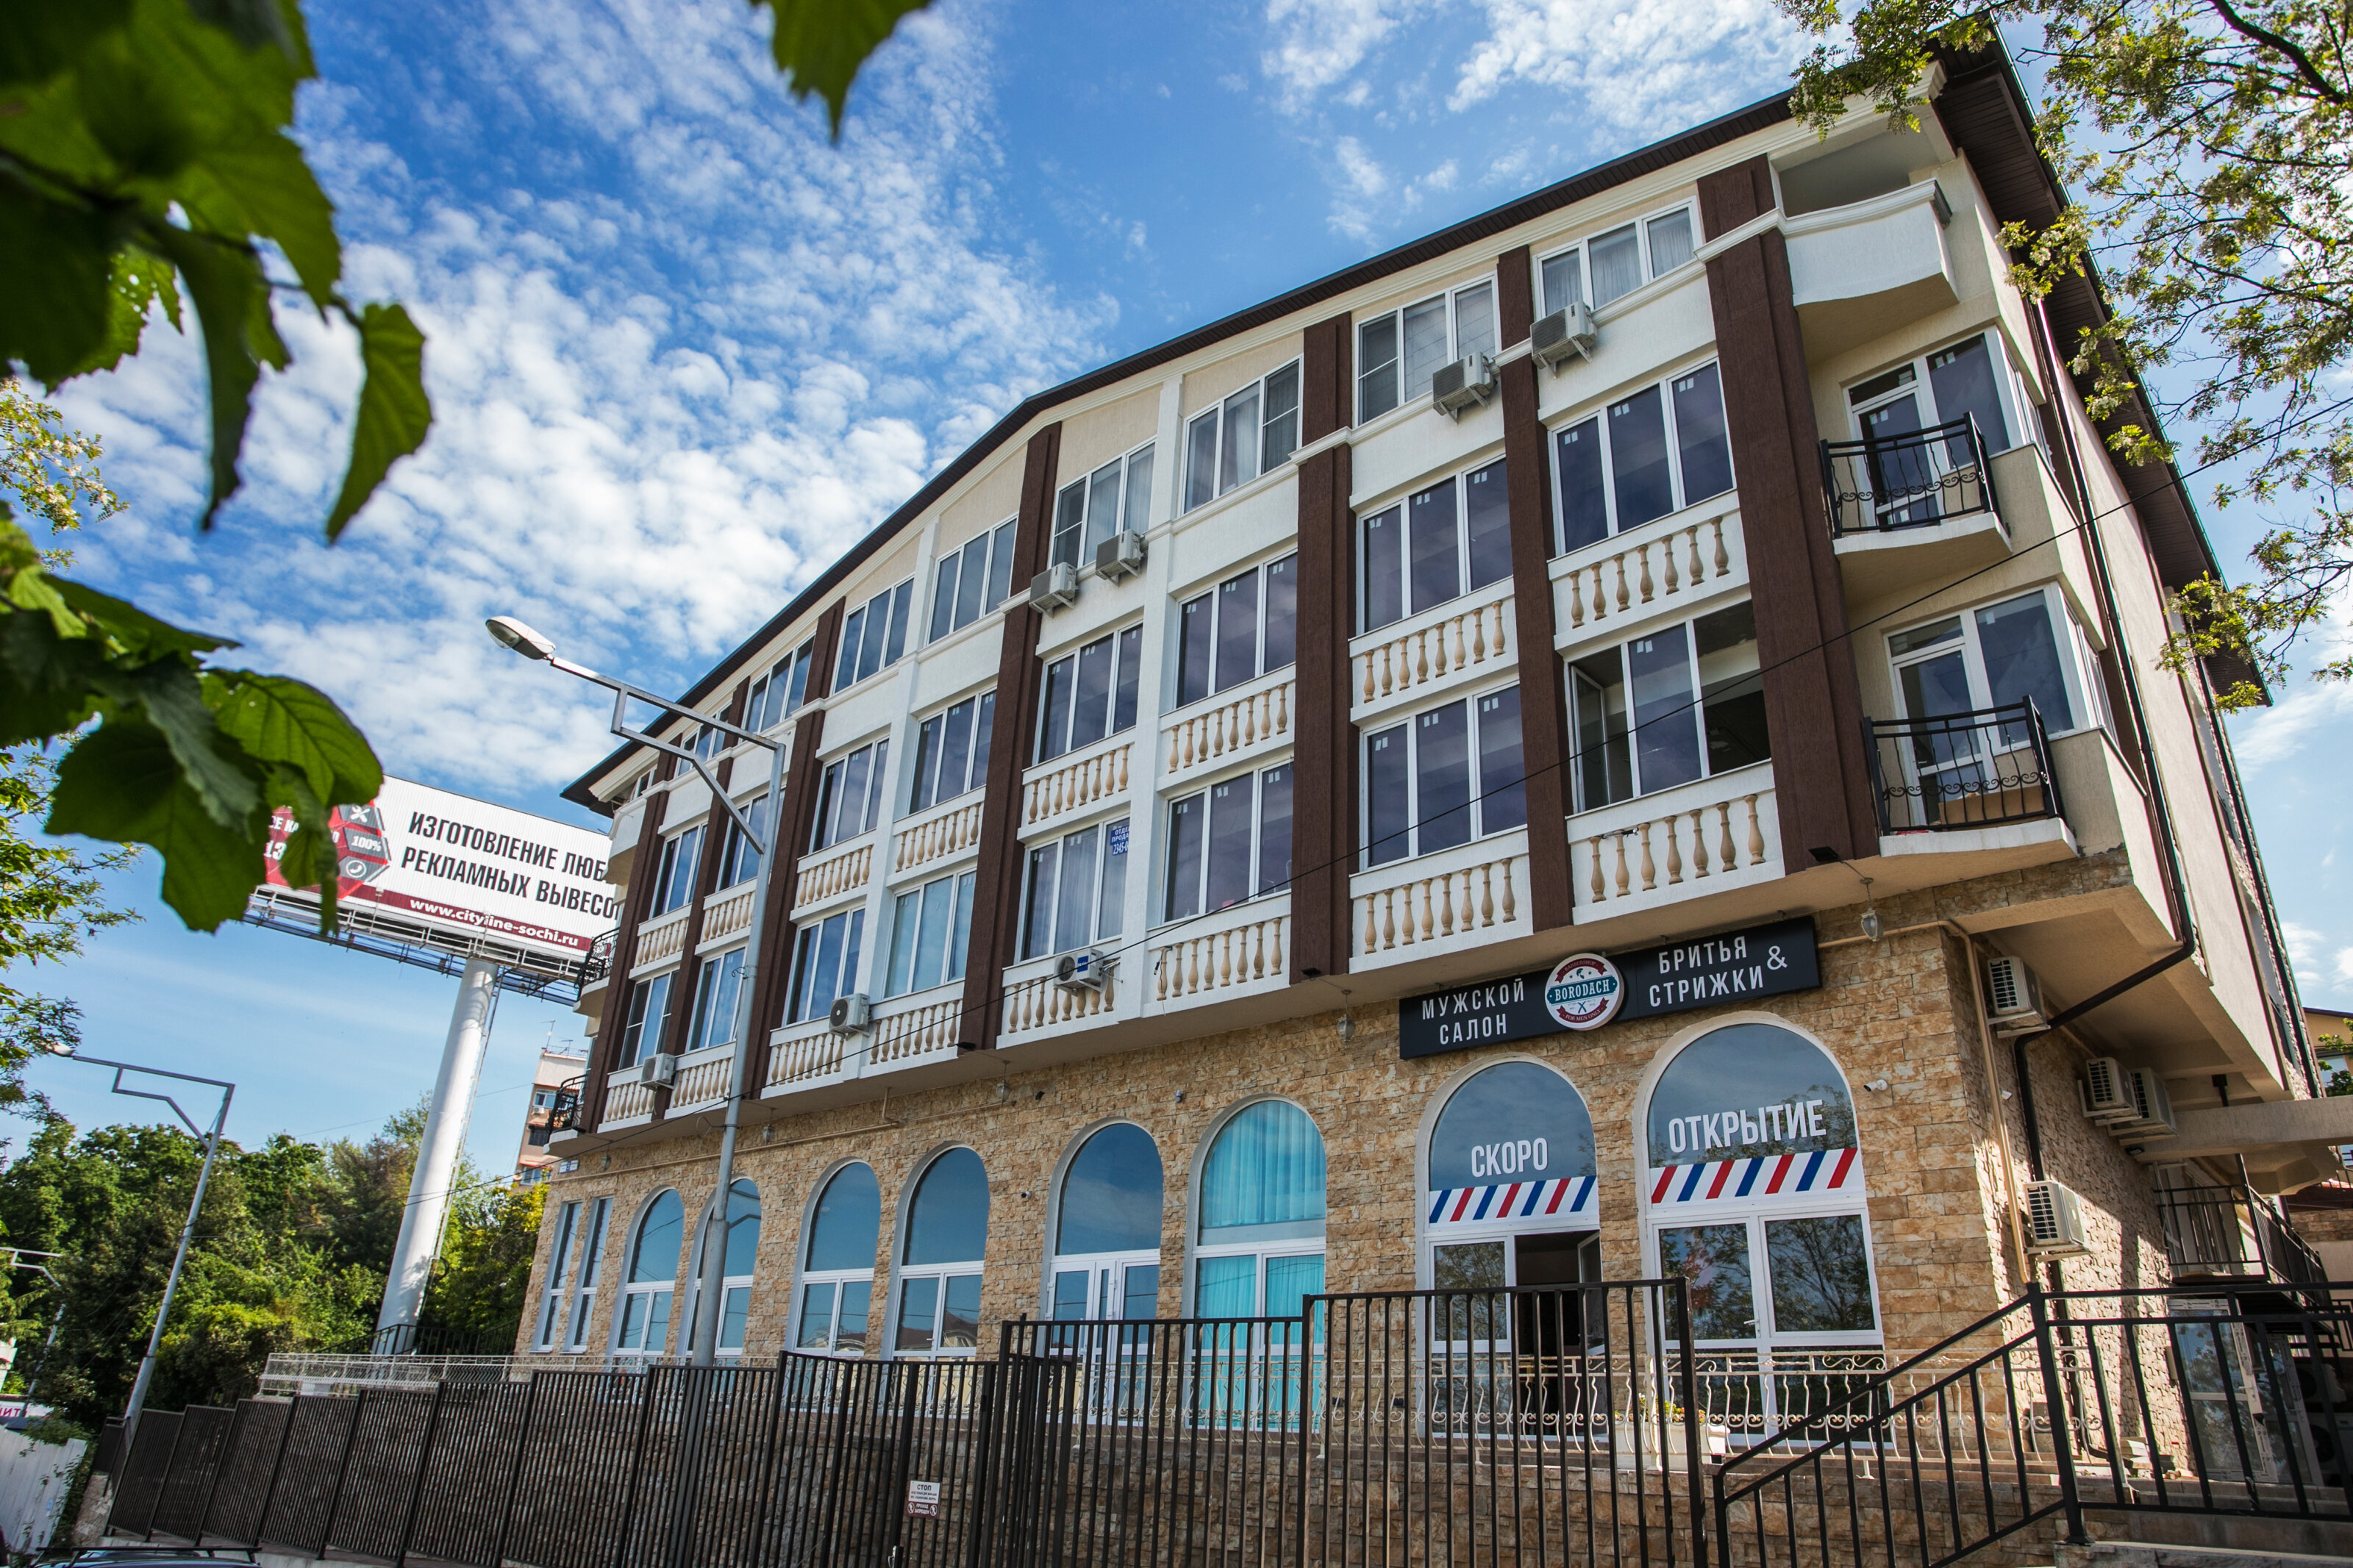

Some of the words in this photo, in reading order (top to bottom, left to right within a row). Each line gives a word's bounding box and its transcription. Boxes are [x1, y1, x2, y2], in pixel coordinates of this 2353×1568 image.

[351, 835, 382, 852] 100%
[408, 811, 558, 870] ИЗГОТОВЛЕНИЕ
[561, 851, 606, 882] ЛЮБ
[1112, 833, 1129, 842] ПРОДА
[1115, 826, 1129, 835] ОТДЕ
[401, 845, 531, 898] РЕКЛАМНЫХ
[1658, 936, 1747, 974] БРИТЬЯ
[1766, 945, 1788, 970] &
[1422, 978, 1524, 1020] МУЖСКОЙ
[1554, 979, 1610, 1001] BORODACH
[1649, 965, 1763, 1007] СТРИЖКИ
[1440, 1013, 1507, 1045] САЛОН
[1588, 1009, 1601, 1019] ONLY
[1668, 1099, 1827, 1153] ОТКРЫТИЕ
[1471, 1137, 1548, 1178] СКОРО
